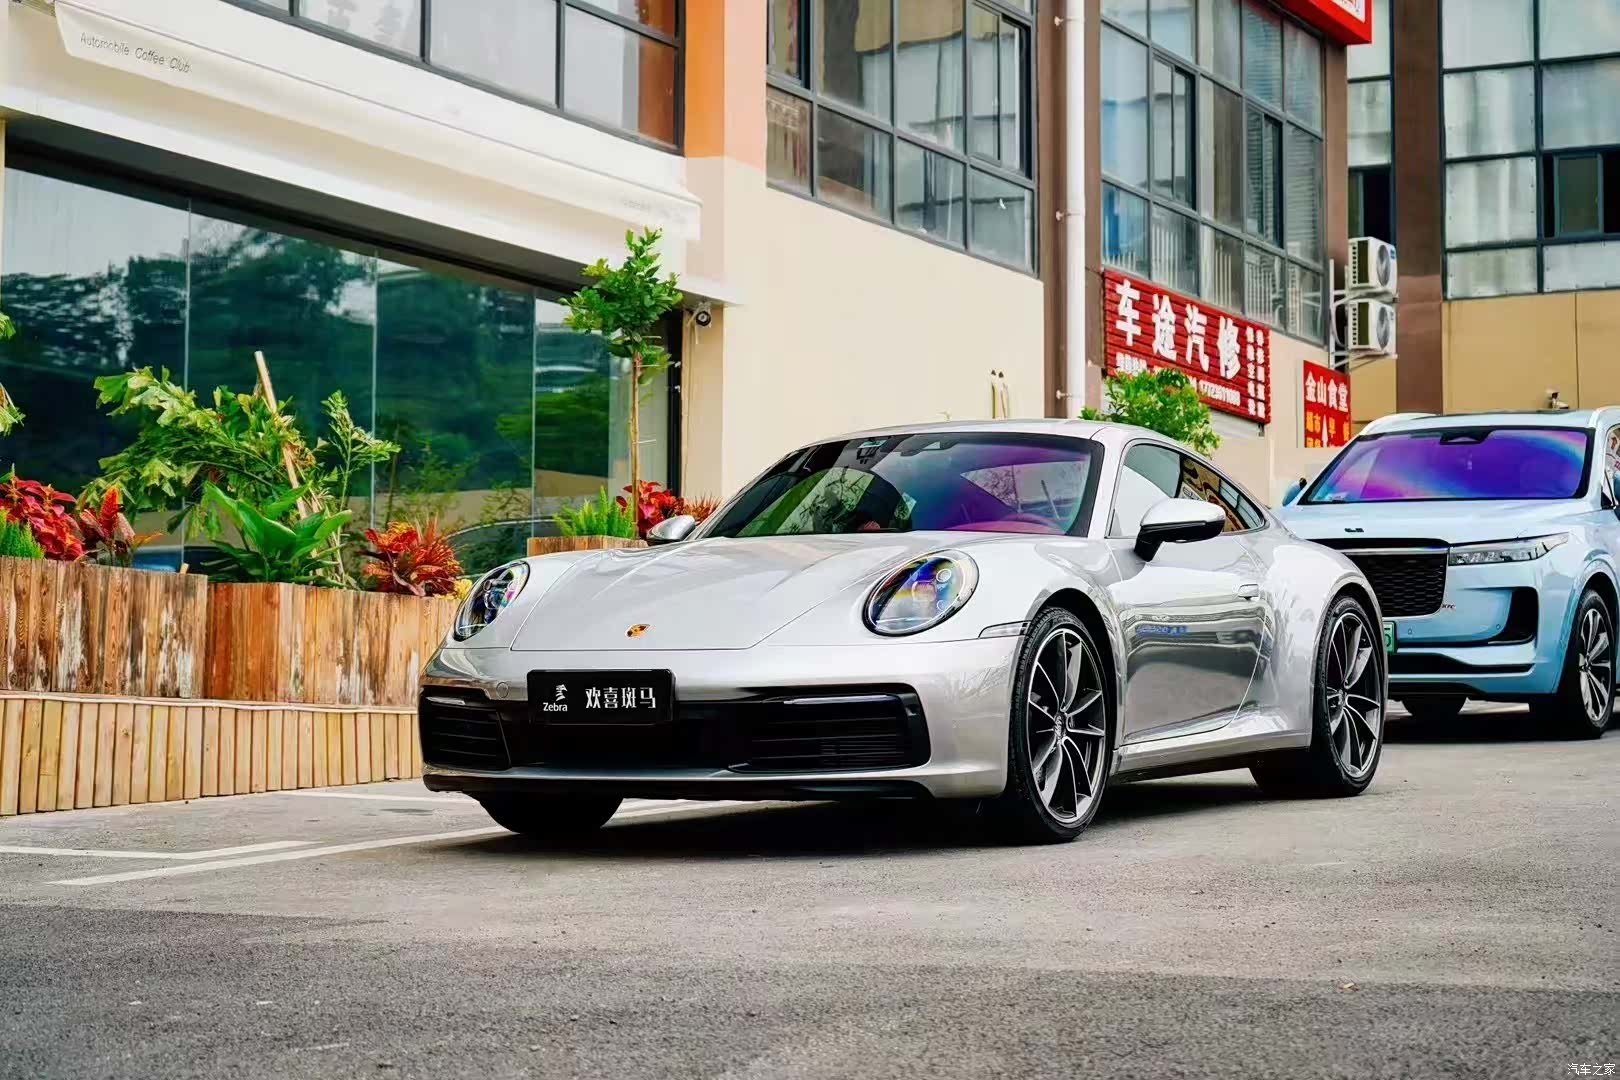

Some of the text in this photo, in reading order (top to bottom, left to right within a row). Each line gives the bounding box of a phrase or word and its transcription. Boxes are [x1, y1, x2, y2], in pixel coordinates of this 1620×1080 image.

[80, 32, 190, 73] Automobile Coffee Club
[1115, 279, 1241, 379] 车途汽修
[1305, 370, 1349, 412] 金山食堂
[543, 702, 568, 712] Zebra
[585, 687, 656, 709] 欢喜斑马
